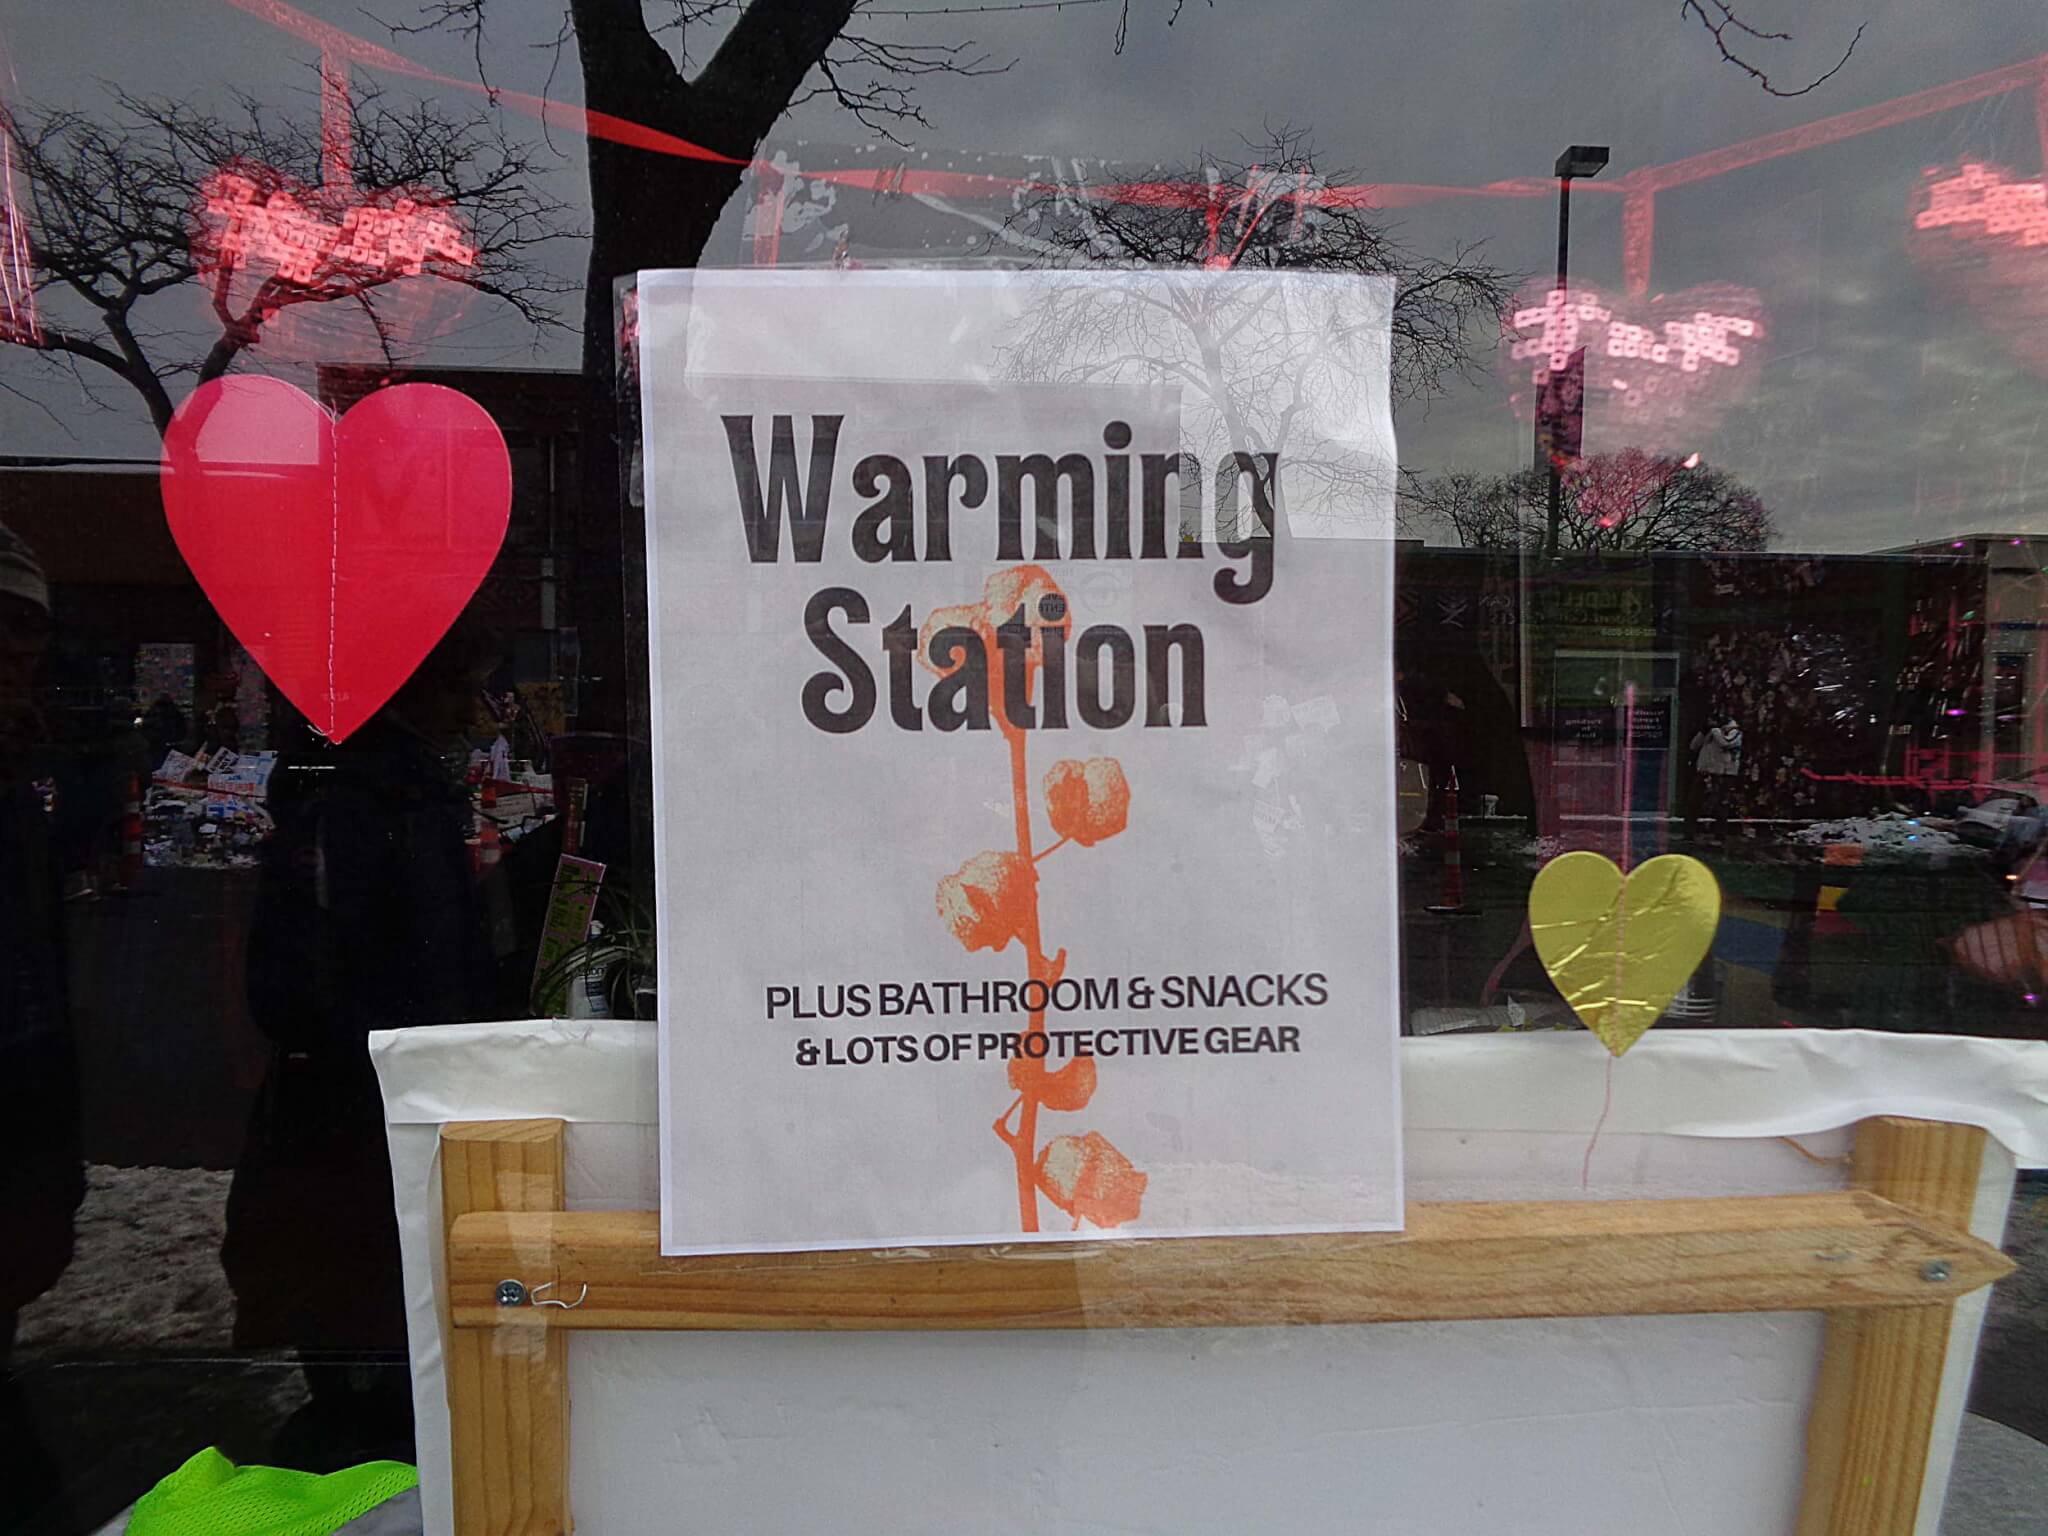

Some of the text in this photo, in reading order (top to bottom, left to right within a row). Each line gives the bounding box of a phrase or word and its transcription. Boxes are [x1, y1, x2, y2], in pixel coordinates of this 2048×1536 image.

[720, 414, 1279, 605] Warming
[802, 587, 1207, 733] Station
[767, 974, 1327, 1019] PLUS BATHROOM & SNACKS
[796, 1026, 1300, 1065] & LOTS OF PROTECTIVE GEAR
